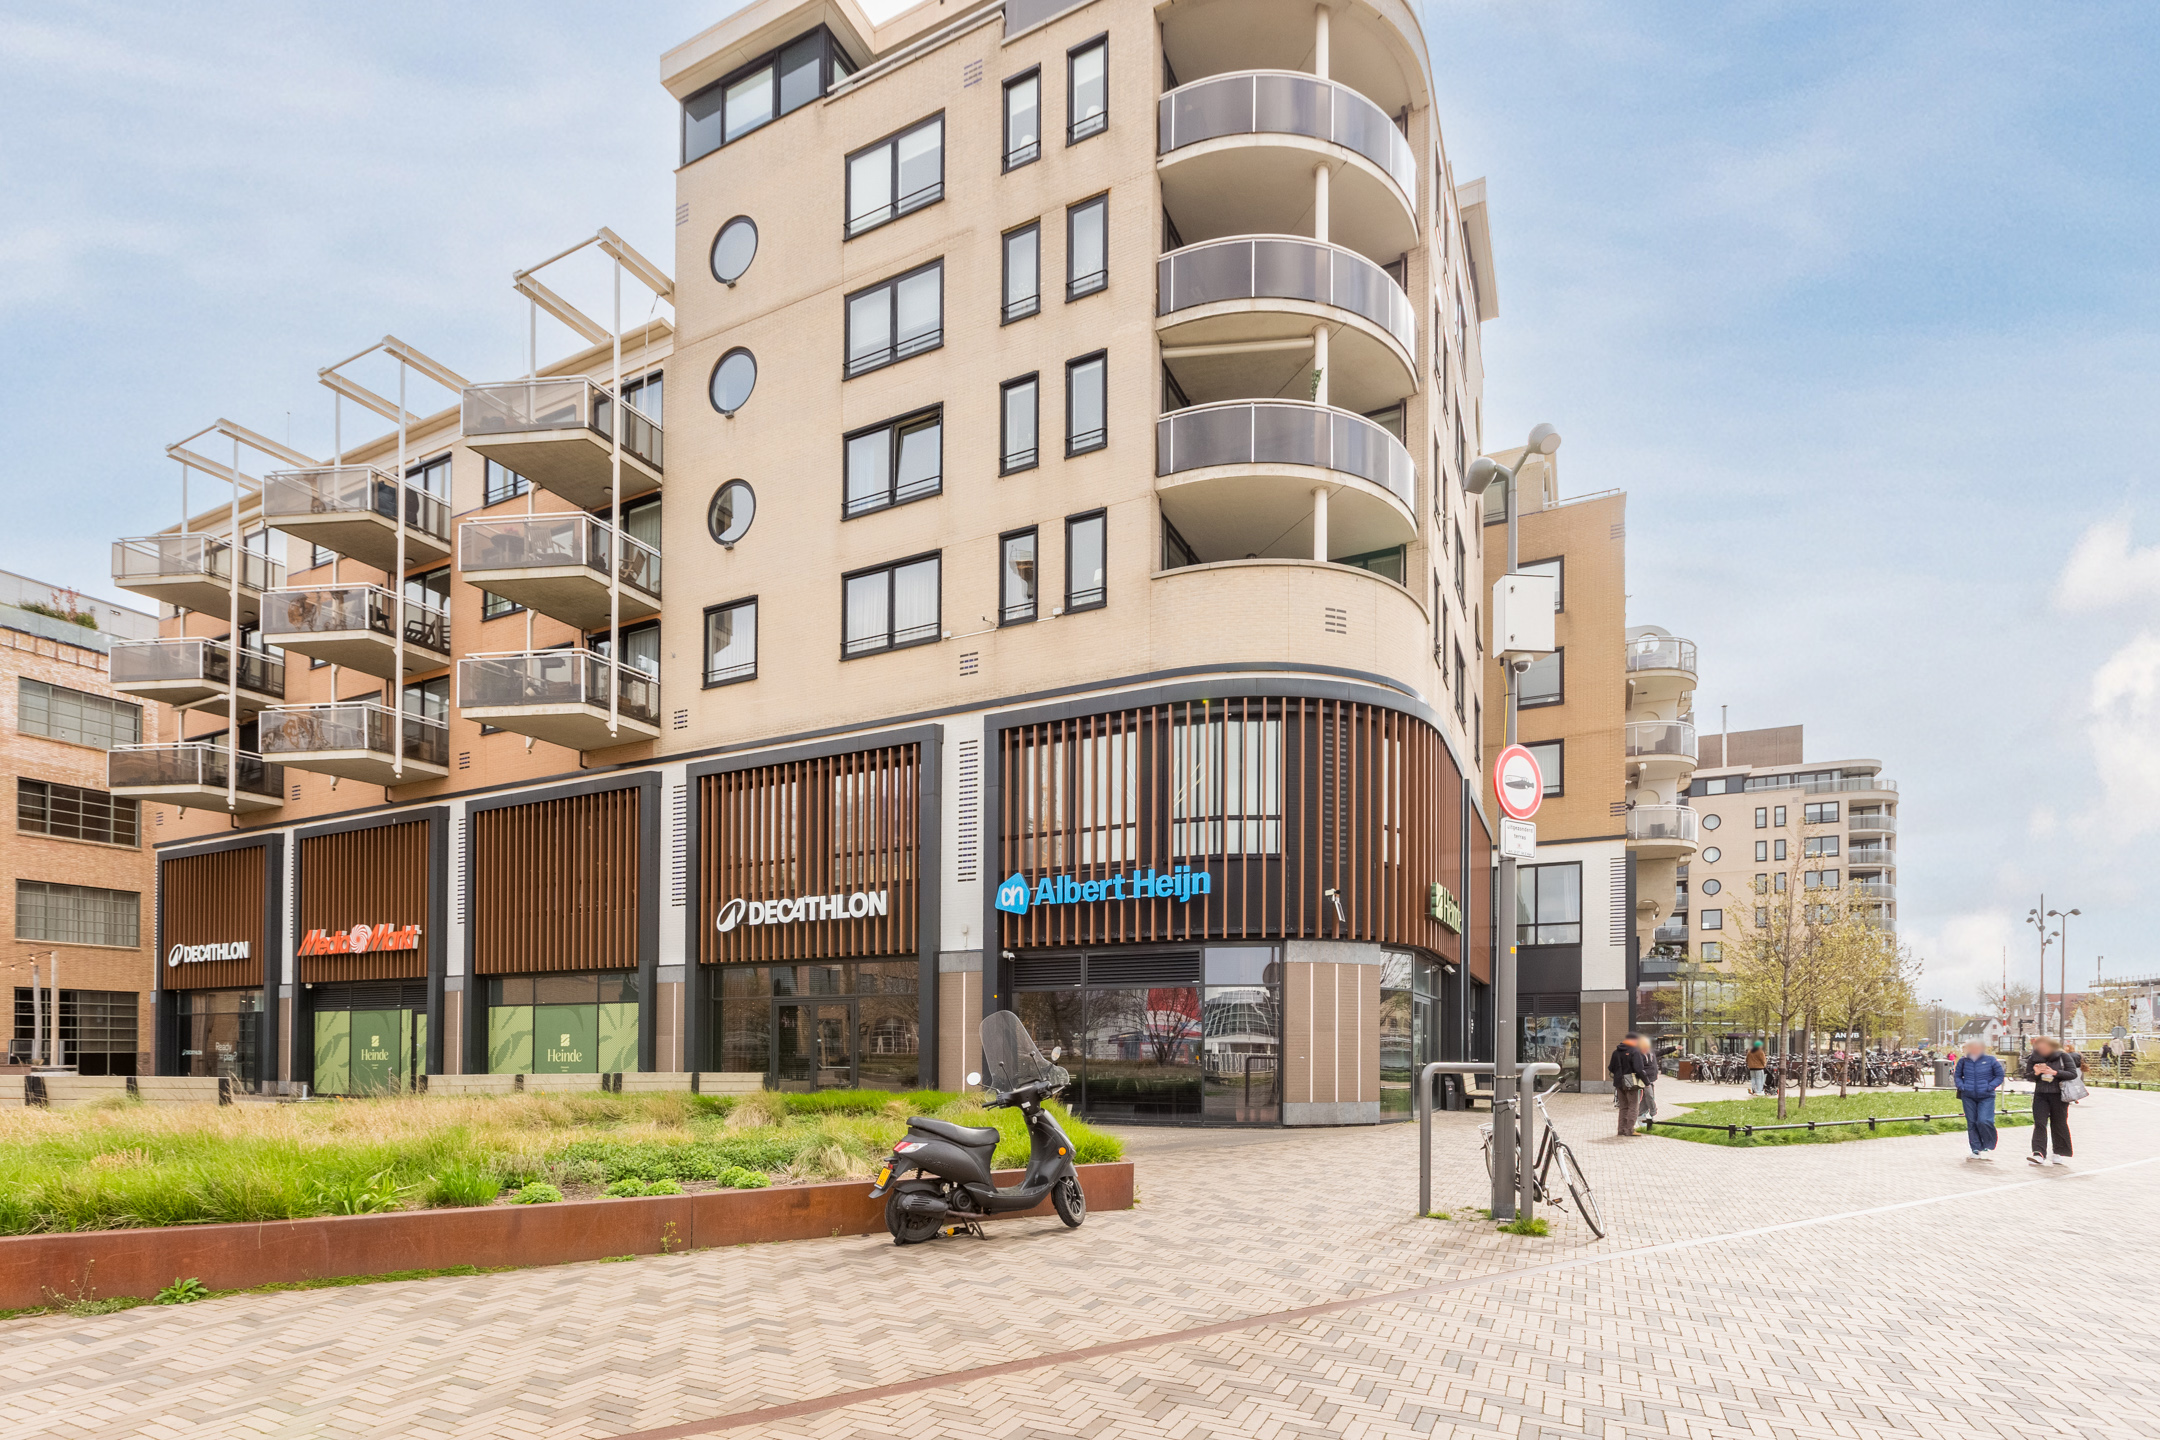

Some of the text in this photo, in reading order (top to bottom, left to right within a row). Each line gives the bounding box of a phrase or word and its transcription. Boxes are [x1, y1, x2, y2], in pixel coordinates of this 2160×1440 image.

[1034, 874, 1126, 905] Albert
[1133, 865, 1211, 902] Heijn
[748, 890, 887, 925] DECATHLON
[183, 941, 250, 963] DECATHLON
[215, 1041, 232, 1053] Ready
[361, 1049, 389, 1060] Heinde
[547, 1048, 583, 1062] Heinde
